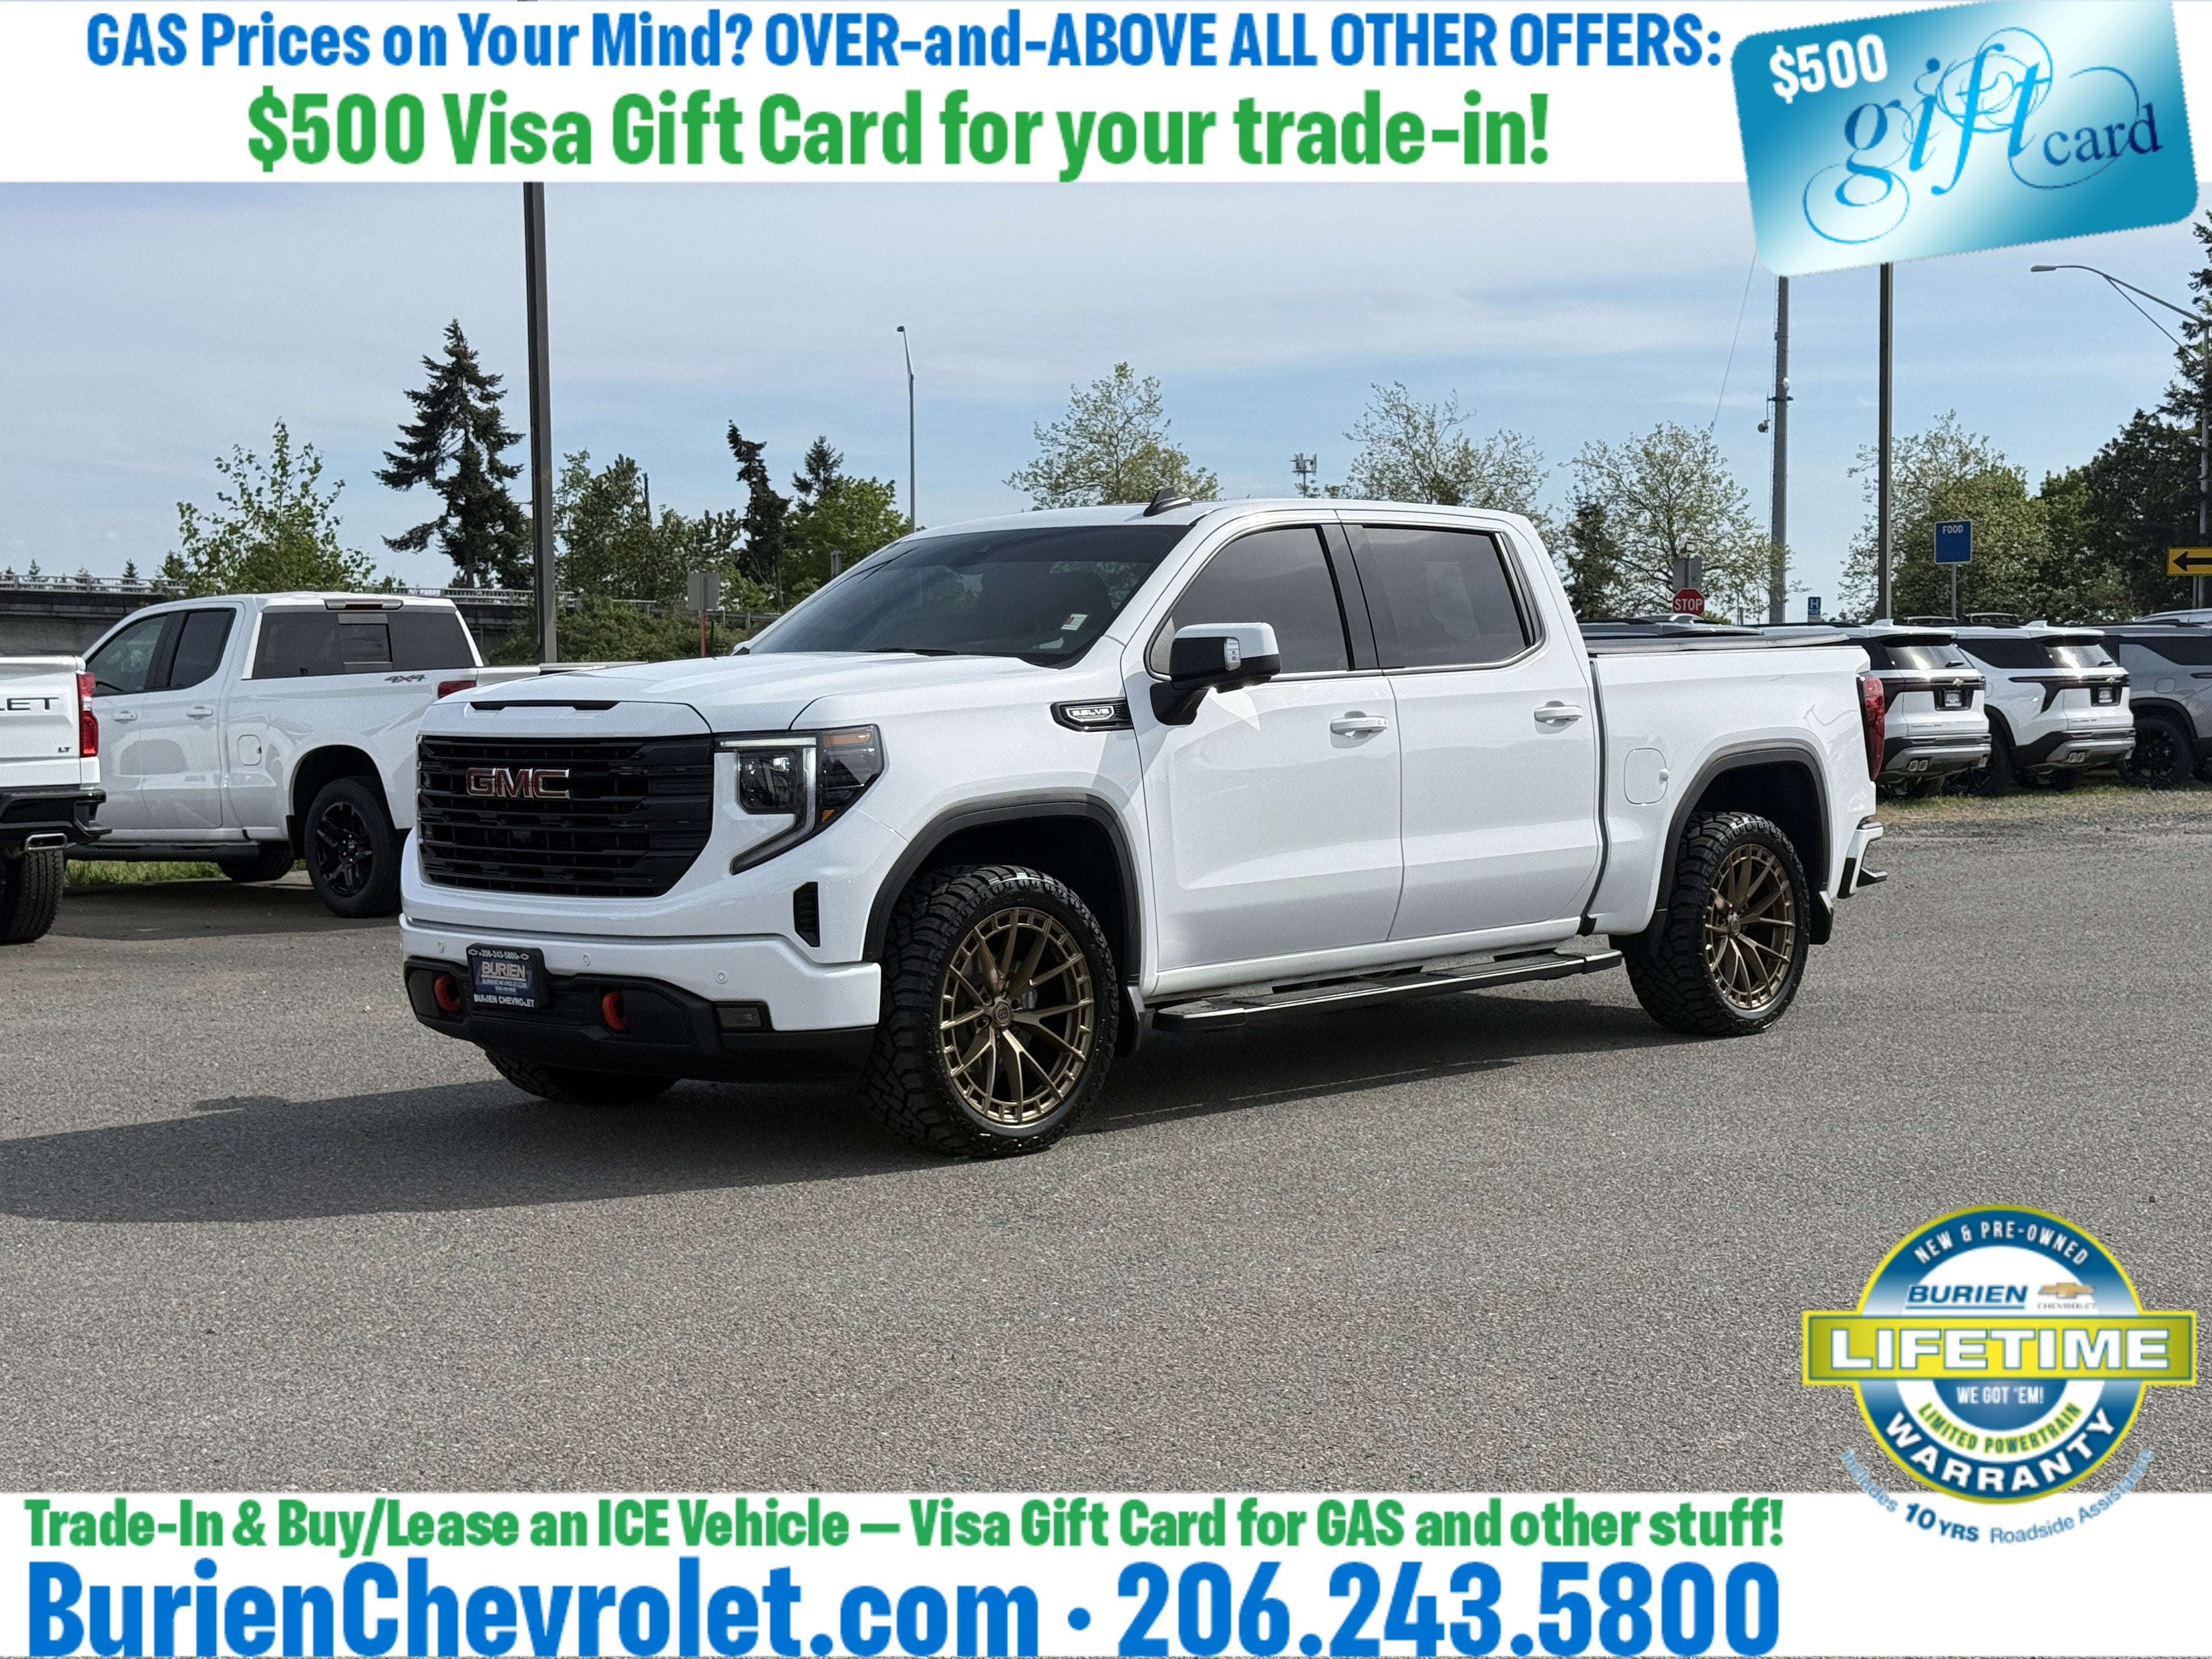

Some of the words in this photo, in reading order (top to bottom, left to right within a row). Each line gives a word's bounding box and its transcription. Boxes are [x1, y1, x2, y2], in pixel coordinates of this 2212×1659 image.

[1943, 524, 1963, 534] FOOD
[1674, 598, 1703, 612] STOP
[1810, 599, 1819, 609] H
[0, 697, 59, 711] ET
[467, 768, 571, 799] GMC
[482, 961, 526, 978] BURIEN
[473, 994, 498, 1004] BURIEN
[498, 996, 535, 1008] CHEVROLET
